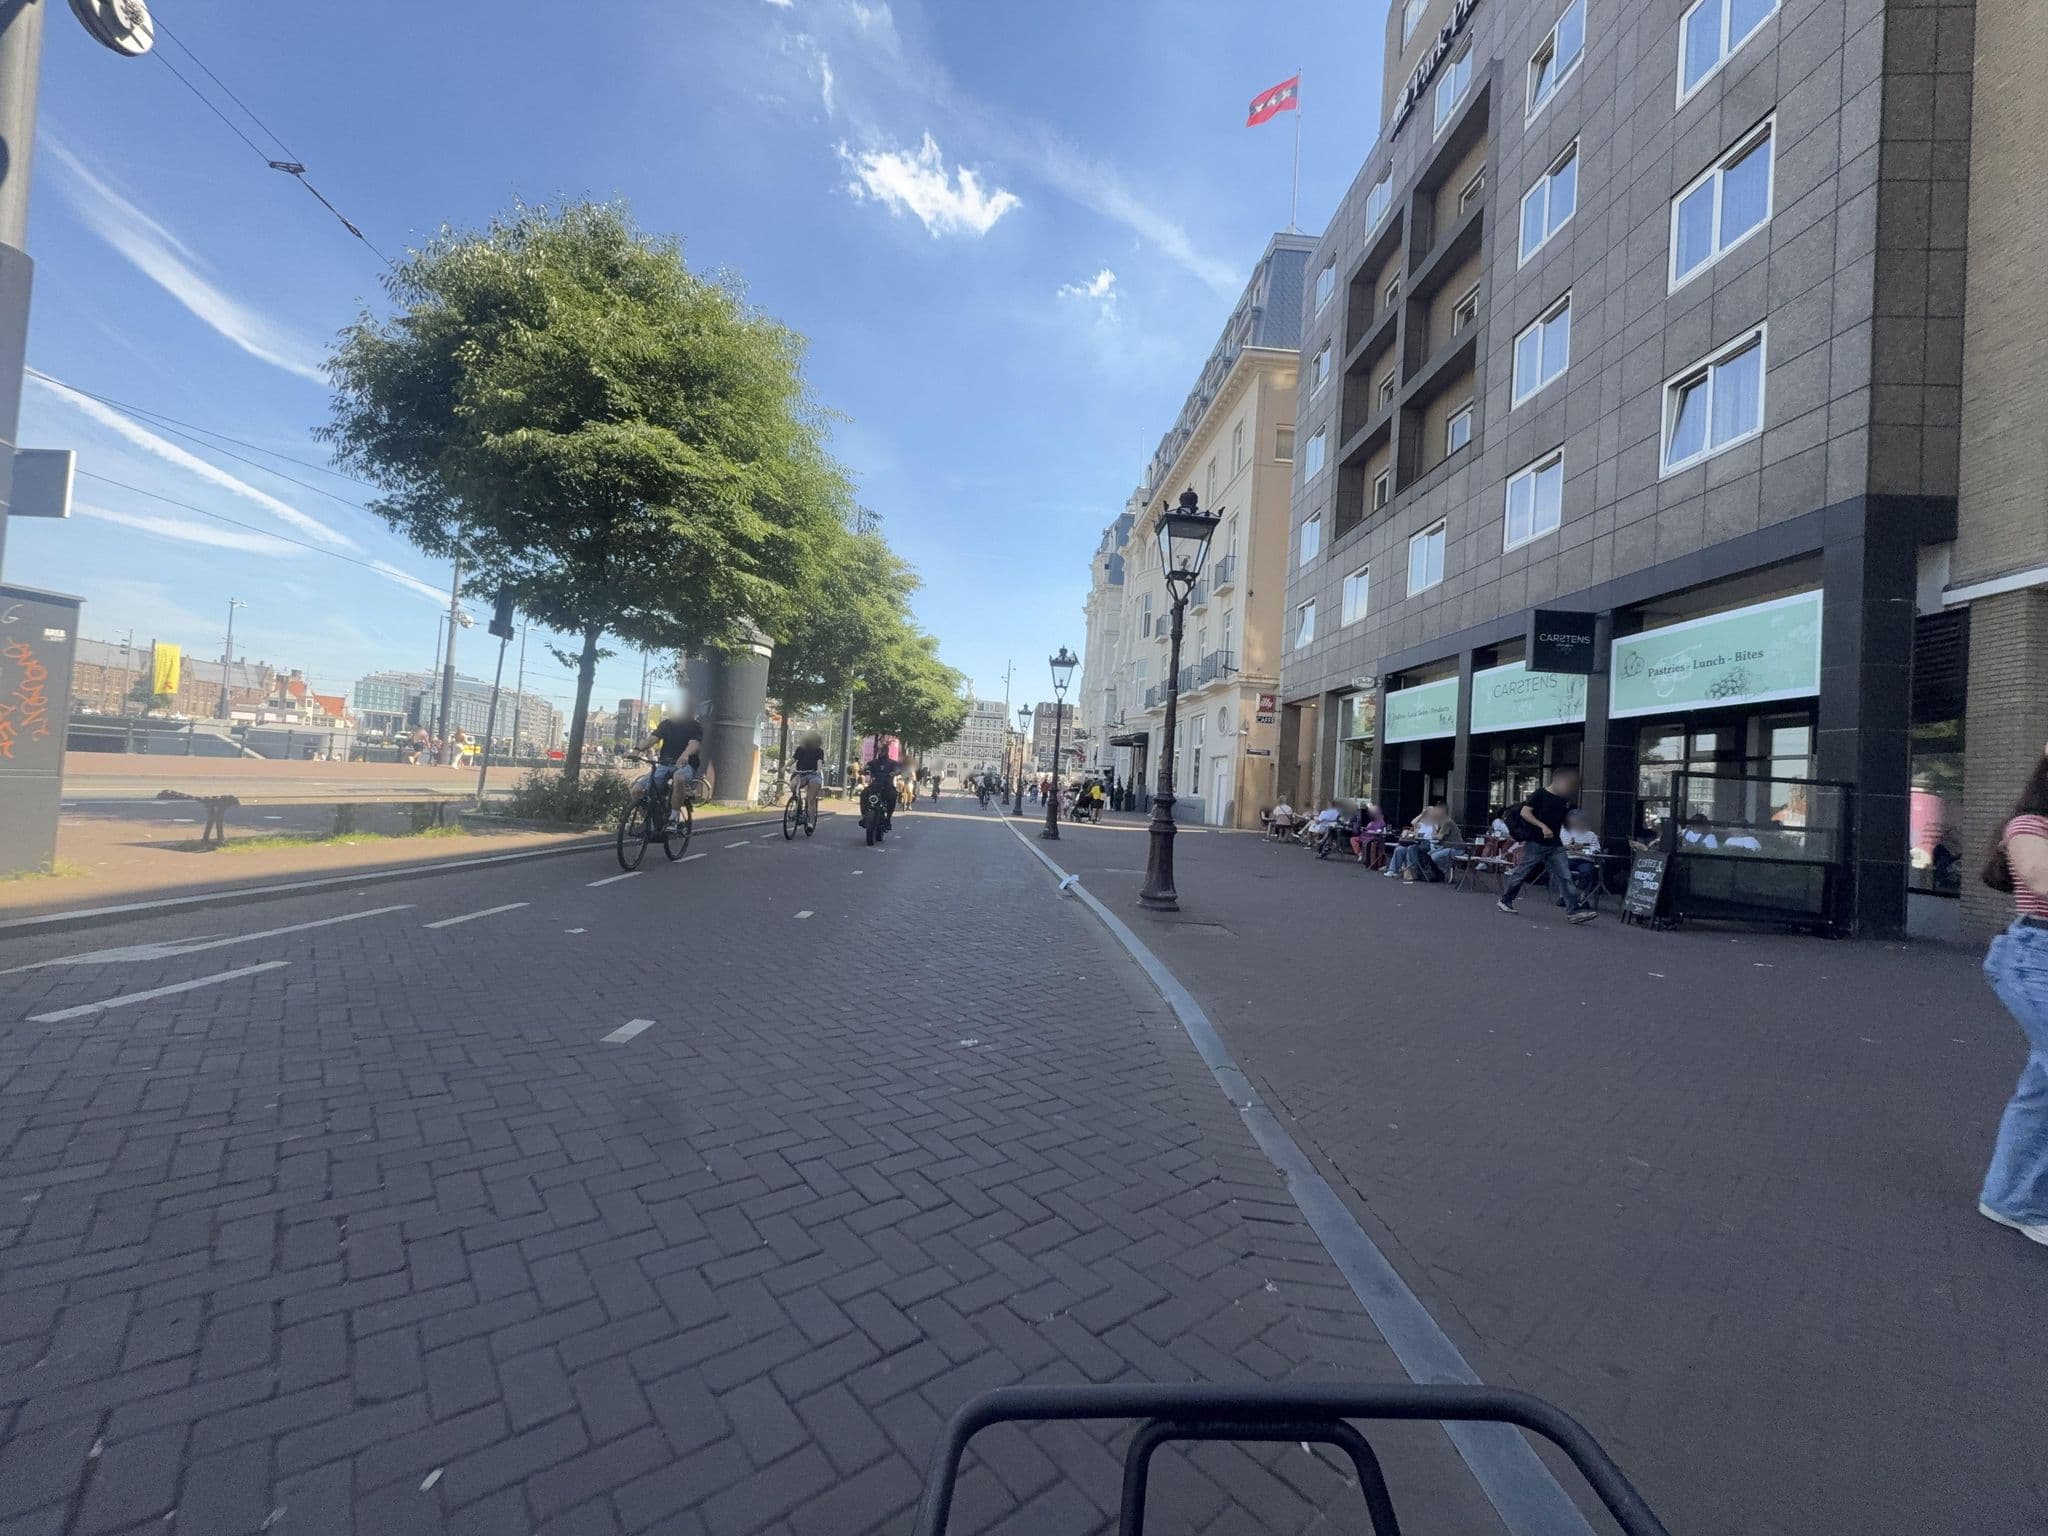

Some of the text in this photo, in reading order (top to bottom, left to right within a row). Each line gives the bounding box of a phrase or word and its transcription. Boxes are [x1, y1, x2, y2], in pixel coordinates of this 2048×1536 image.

[1539, 633, 1591, 644] CARSTENS
[1648, 664, 1685, 677] Pastries
[1693, 655, 1725, 669] Lunch
[1735, 649, 1764, 662] Bites
[1493, 674, 1558, 698] CARSTENS
